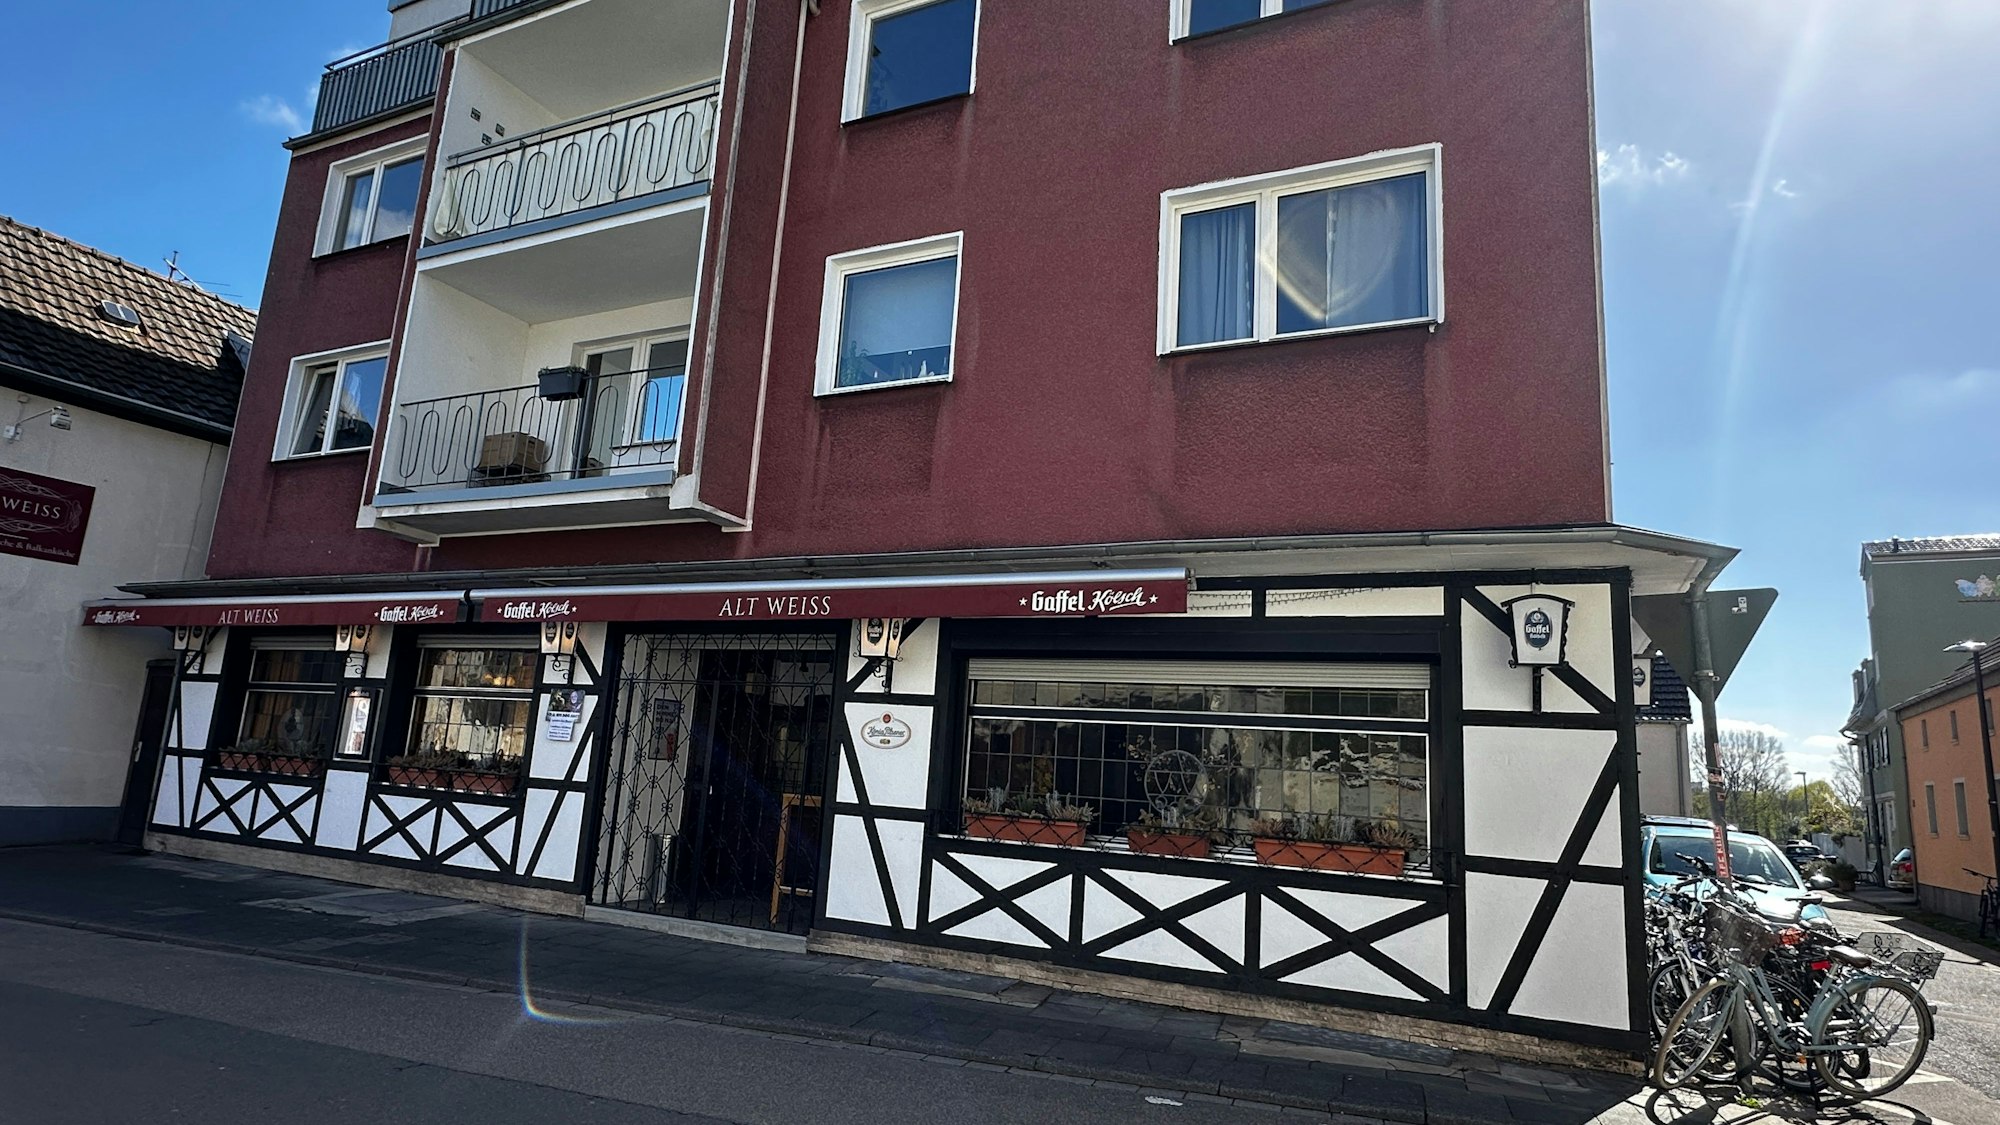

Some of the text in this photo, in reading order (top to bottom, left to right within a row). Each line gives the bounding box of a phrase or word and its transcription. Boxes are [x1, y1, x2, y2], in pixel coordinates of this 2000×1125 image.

[2, 496, 61, 519] WEISS
[16, 541, 24, 549] &
[718, 595, 831, 616] ALT WEISS
[1031, 587, 1146, 613] Gaffel Kölsch
[218, 608, 280, 624] ALT WEISS
[380, 604, 438, 622] Gaffel Kölsch
[503, 600, 570, 619] Gaffel Kölsch
[1525, 624, 1550, 634] Gaffel
